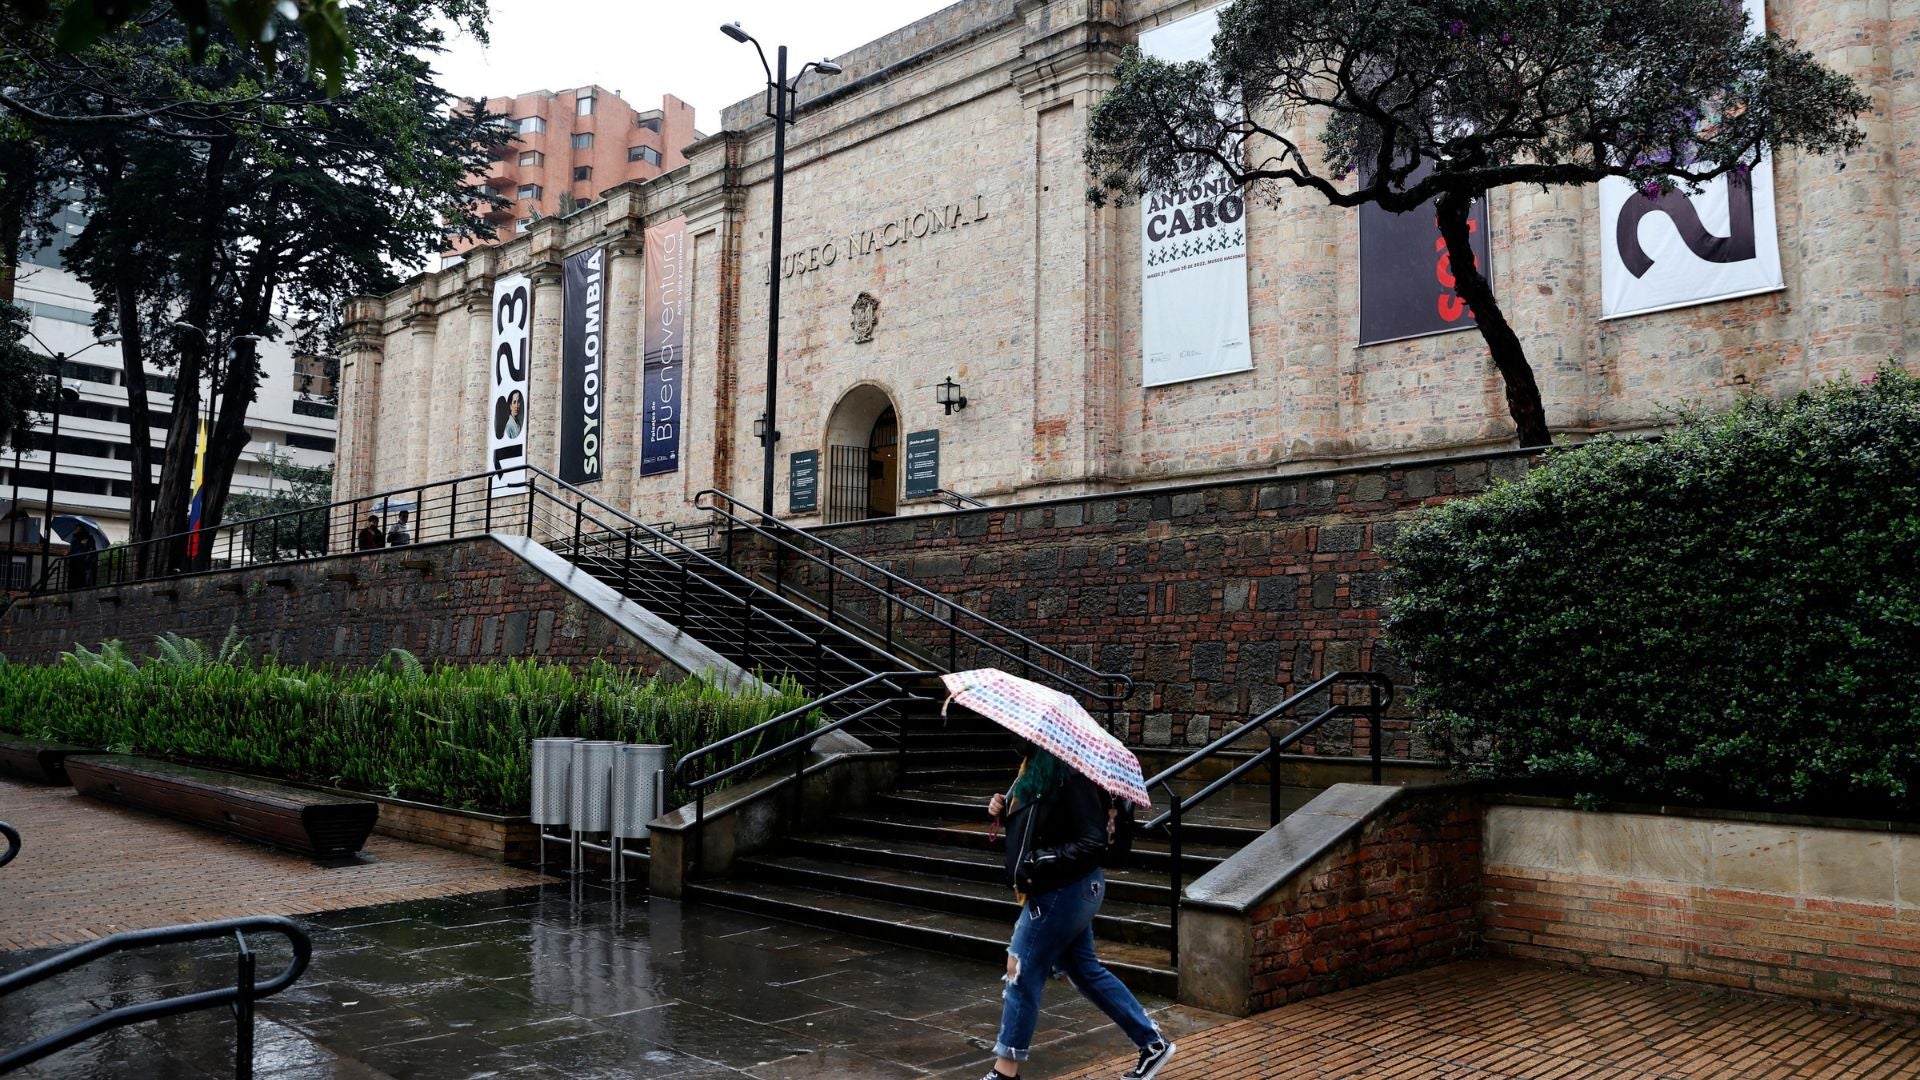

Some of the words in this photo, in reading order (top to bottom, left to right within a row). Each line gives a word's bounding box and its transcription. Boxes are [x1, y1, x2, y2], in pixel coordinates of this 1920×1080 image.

[848, 194, 989, 260] NACIONAL
[1147, 195, 1244, 242] CARO
[1207, 256, 1223, 264] MUSEO
[656, 233, 676, 441] Buenaventura
